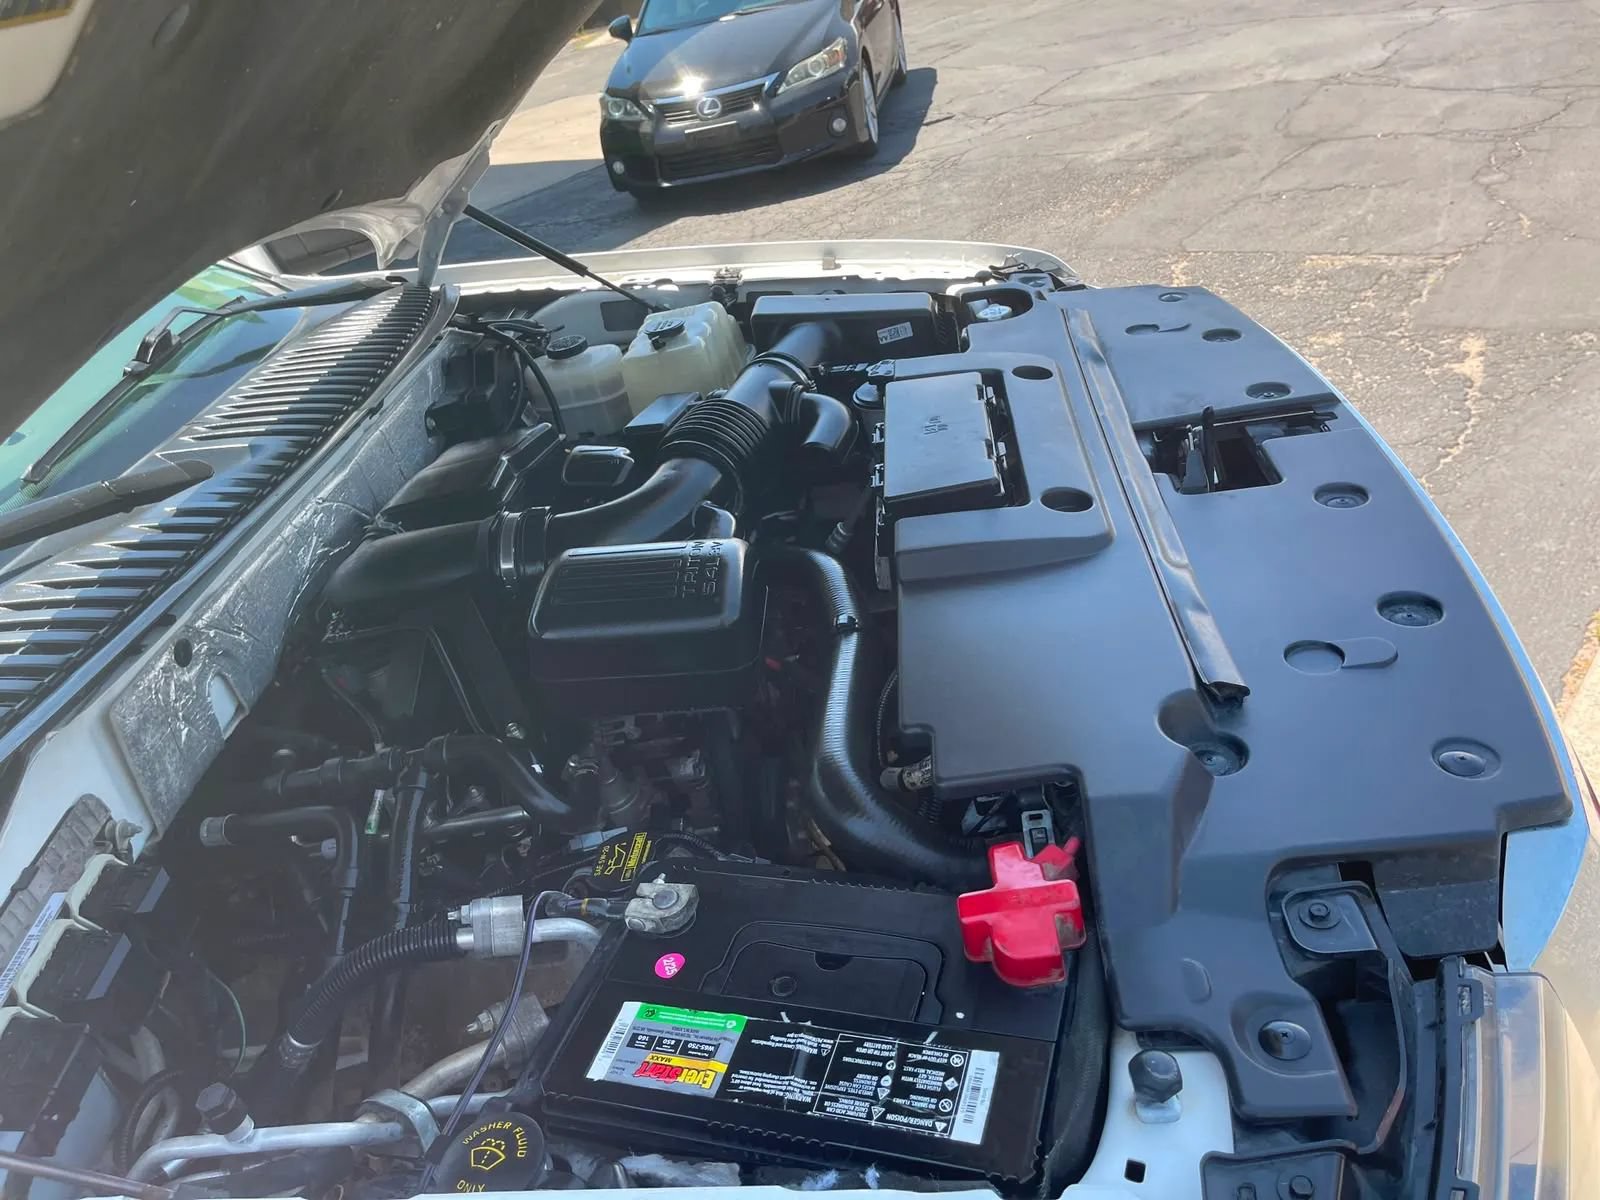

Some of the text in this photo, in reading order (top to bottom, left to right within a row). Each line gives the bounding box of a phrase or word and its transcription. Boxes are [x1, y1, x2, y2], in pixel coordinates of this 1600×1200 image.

[682, 541, 704, 598] TRITON
[598, 845, 609, 863] 5W-20
[687, 1042, 714, 1051] W65-750
[648, 1054, 671, 1063] MAXX
[842, 1056, 871, 1064] INSTRUCTIONS
[632, 1062, 715, 1088] EverStart
[824, 1083, 846, 1091] EXPLOSIVE
[914, 1077, 942, 1086] IMMEDIATELY
[830, 1101, 854, 1109] BLINDNESS
[885, 1113, 932, 1126] DANGER/POISON
[462, 1121, 527, 1157] WASHER FLUID
[456, 1179, 485, 1192] ONLY
